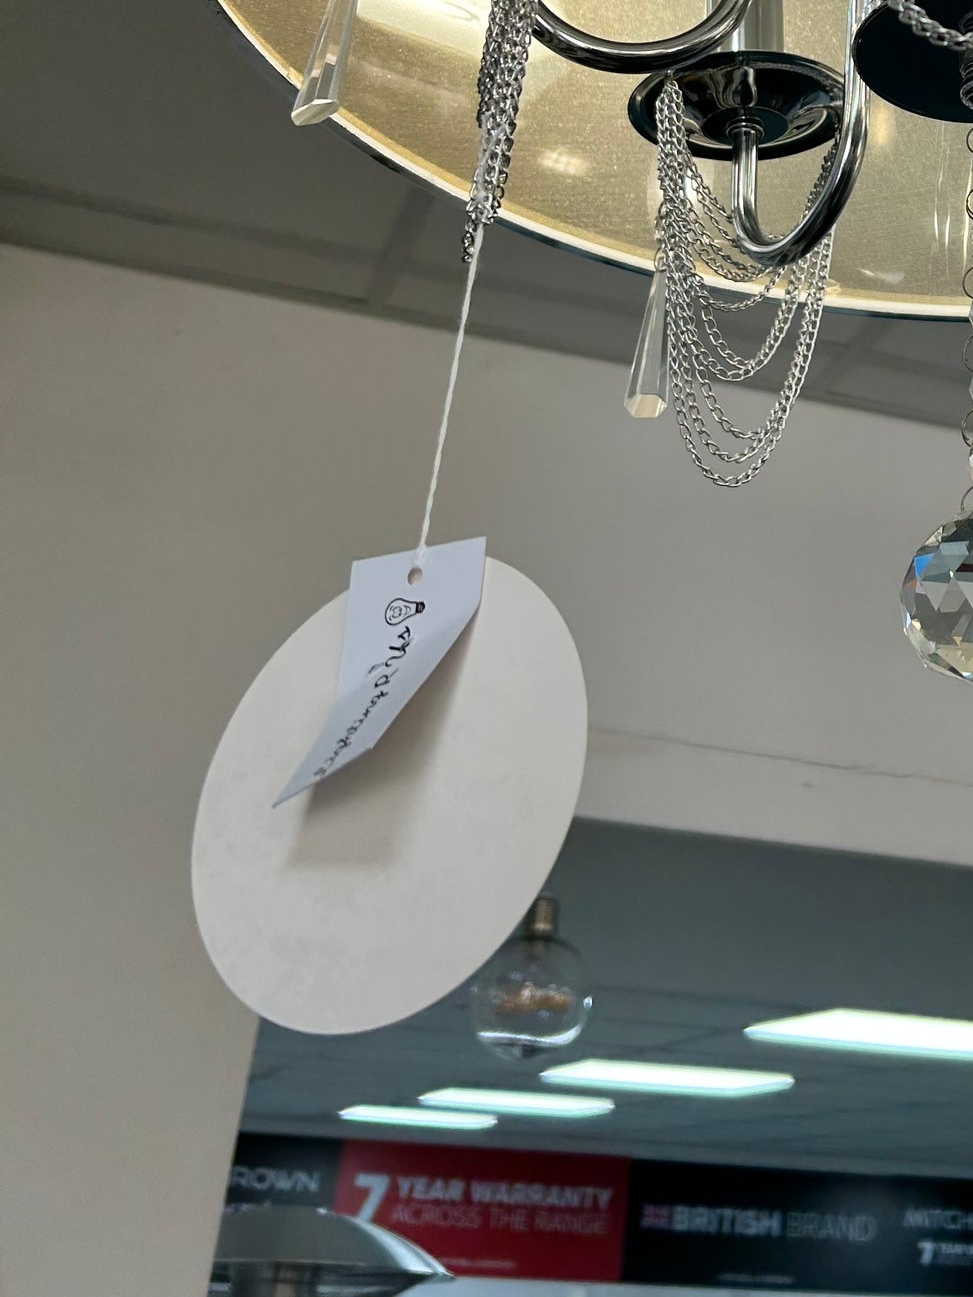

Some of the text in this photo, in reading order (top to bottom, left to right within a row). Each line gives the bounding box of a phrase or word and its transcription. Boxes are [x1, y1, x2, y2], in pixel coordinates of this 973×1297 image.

[374, 668, 399, 689] R
[231, 1165, 320, 1193] ROWN
[354, 1172, 613, 1223] 7 YEAR WARRANTY
[391, 1203, 610, 1236] ACROSS THE RANGE
[671, 1205, 878, 1242] BRITISH BRAND
